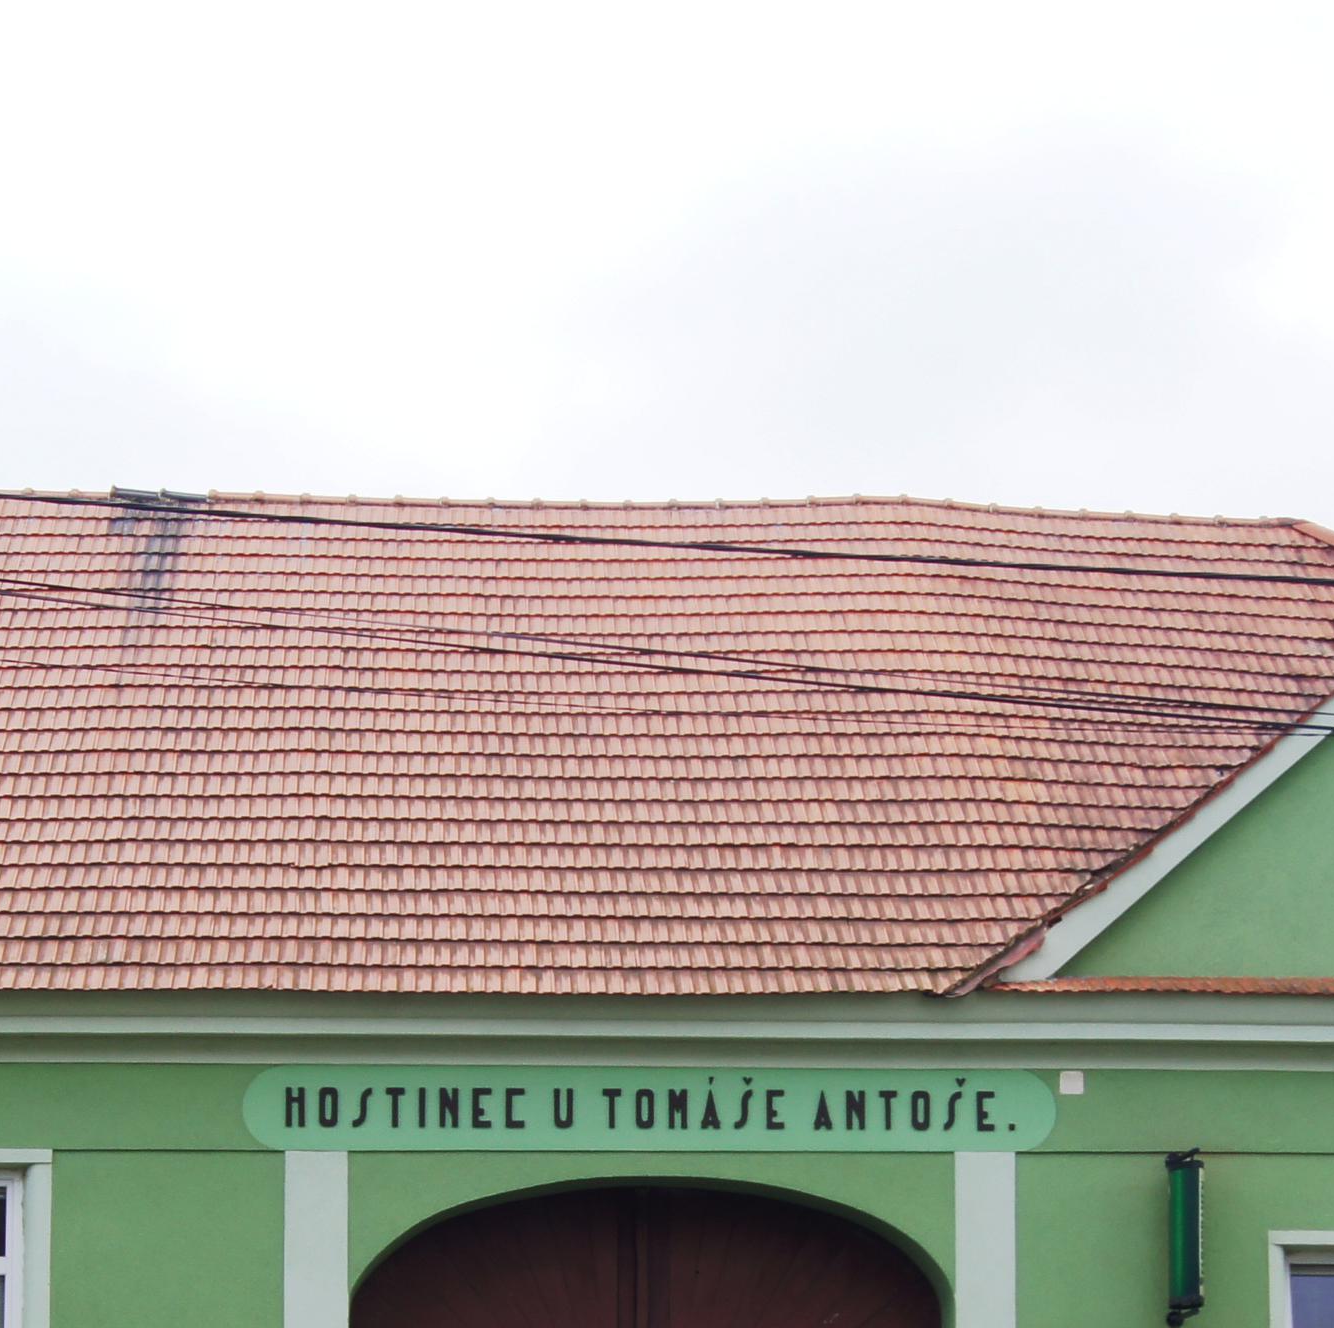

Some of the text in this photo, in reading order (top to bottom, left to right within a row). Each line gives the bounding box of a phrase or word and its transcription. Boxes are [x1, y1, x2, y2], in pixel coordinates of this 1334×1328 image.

[284, 1076, 1016, 1132] HOSTINEC U TOMÁŠE ANTOŠE.
